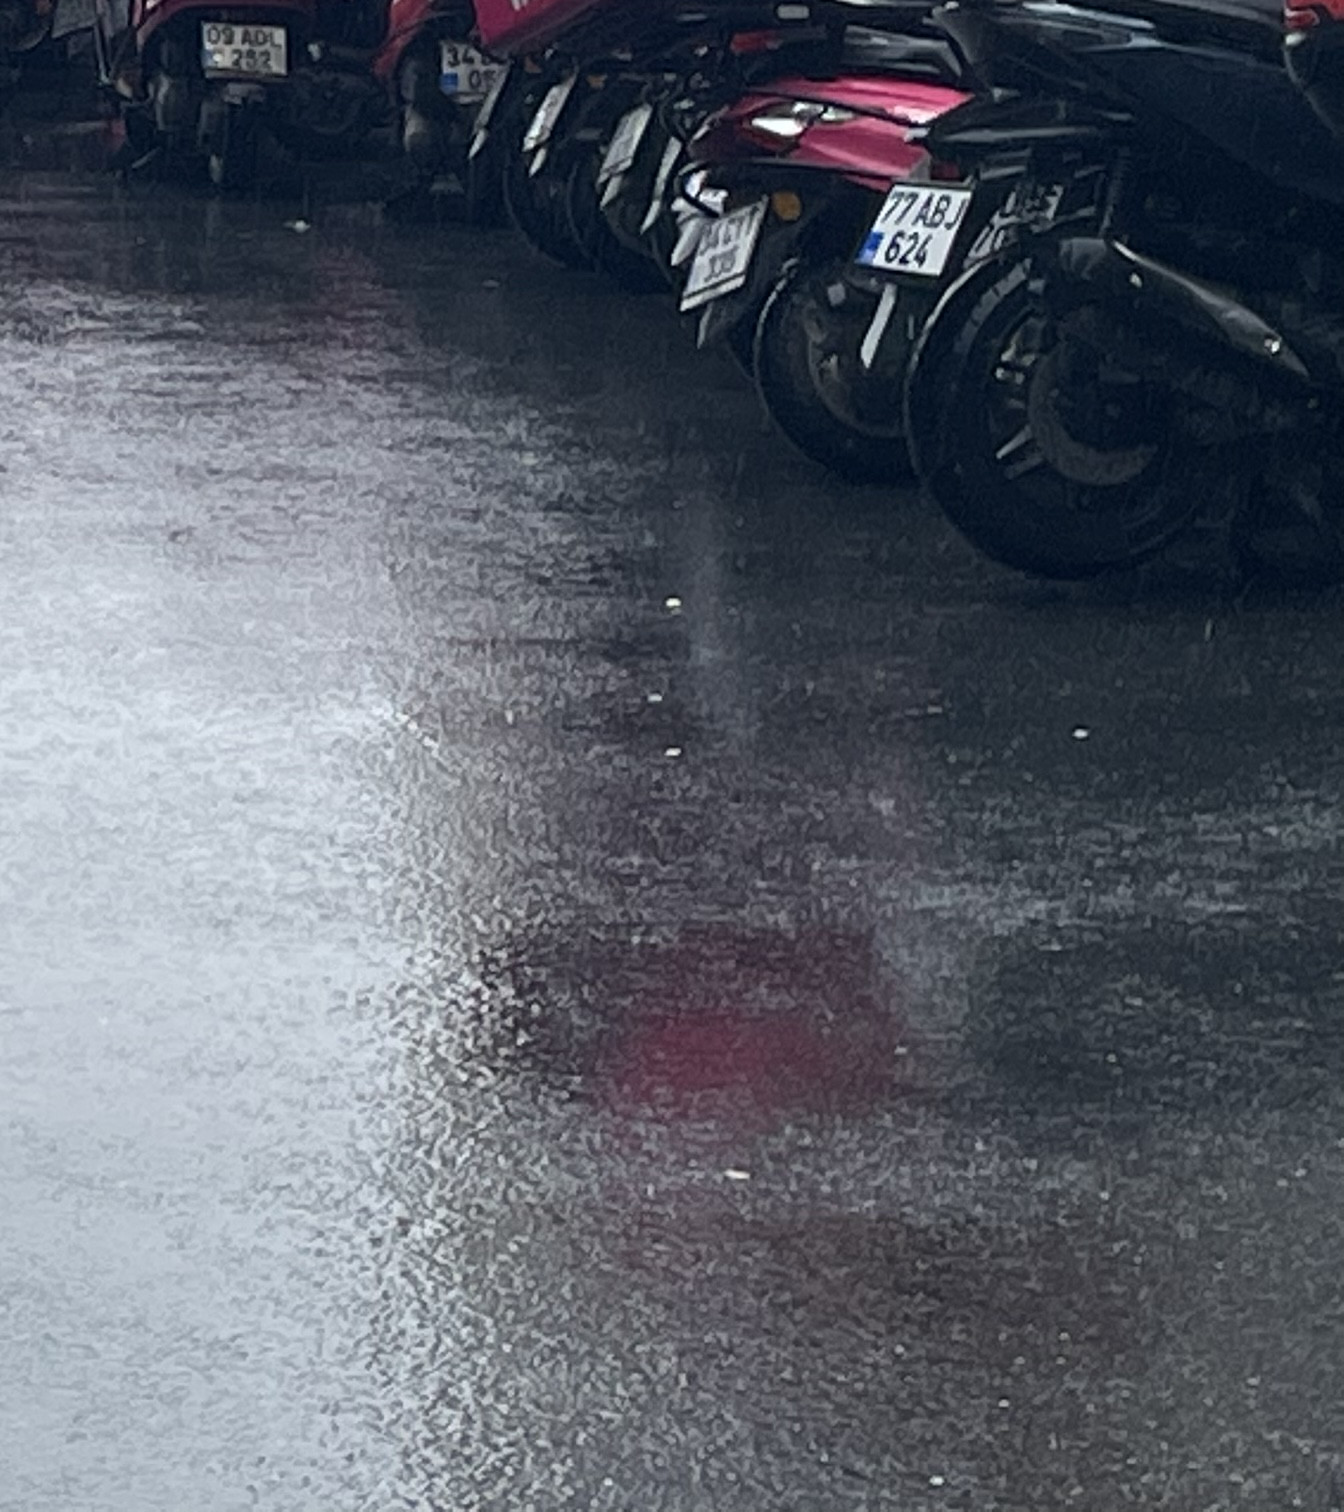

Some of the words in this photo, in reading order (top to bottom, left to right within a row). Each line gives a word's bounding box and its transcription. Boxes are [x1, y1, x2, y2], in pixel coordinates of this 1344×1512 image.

[880, 191, 919, 226] 77
[911, 192, 969, 230] ABJ
[884, 230, 933, 268] 624
